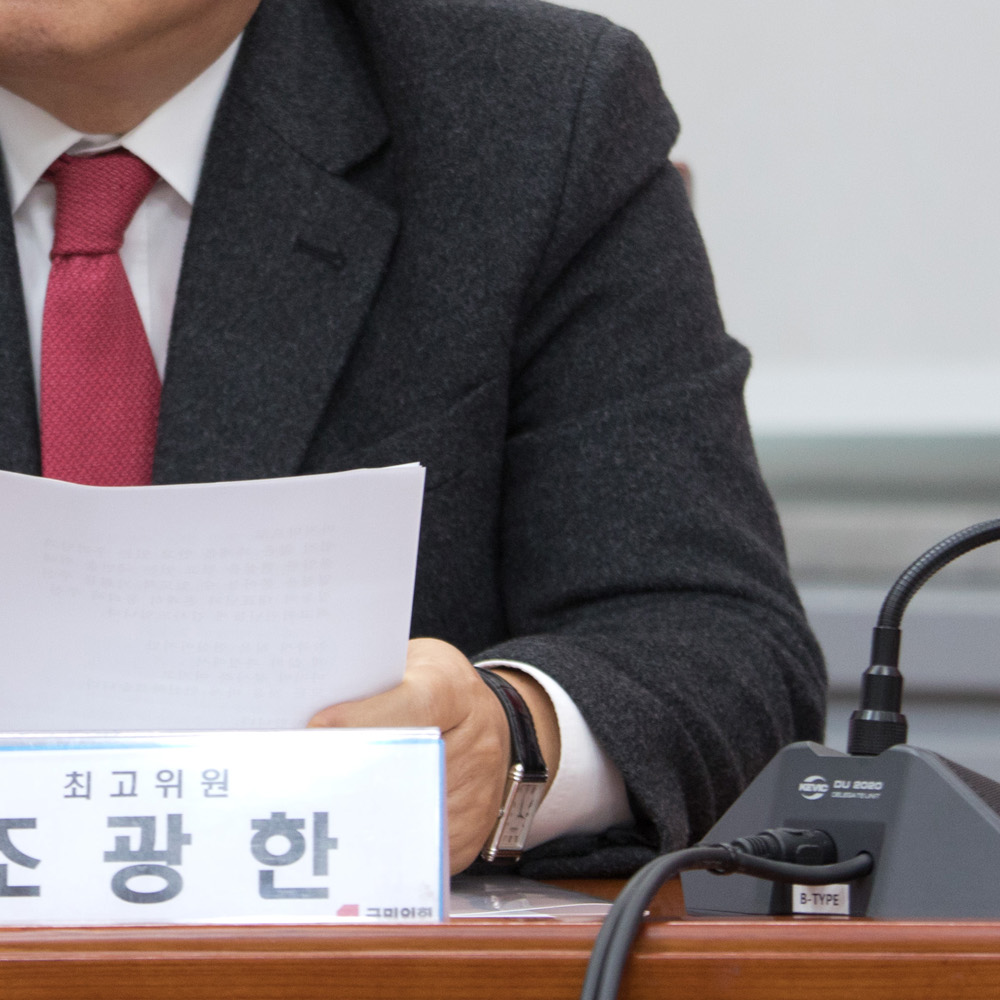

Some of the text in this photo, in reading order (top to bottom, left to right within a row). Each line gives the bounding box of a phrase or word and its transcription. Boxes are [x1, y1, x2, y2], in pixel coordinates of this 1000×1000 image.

[63, 769, 229, 800] 최고위원
[833, 780, 884, 790] DU 2020
[800, 893, 839, 906] B-TYPE
